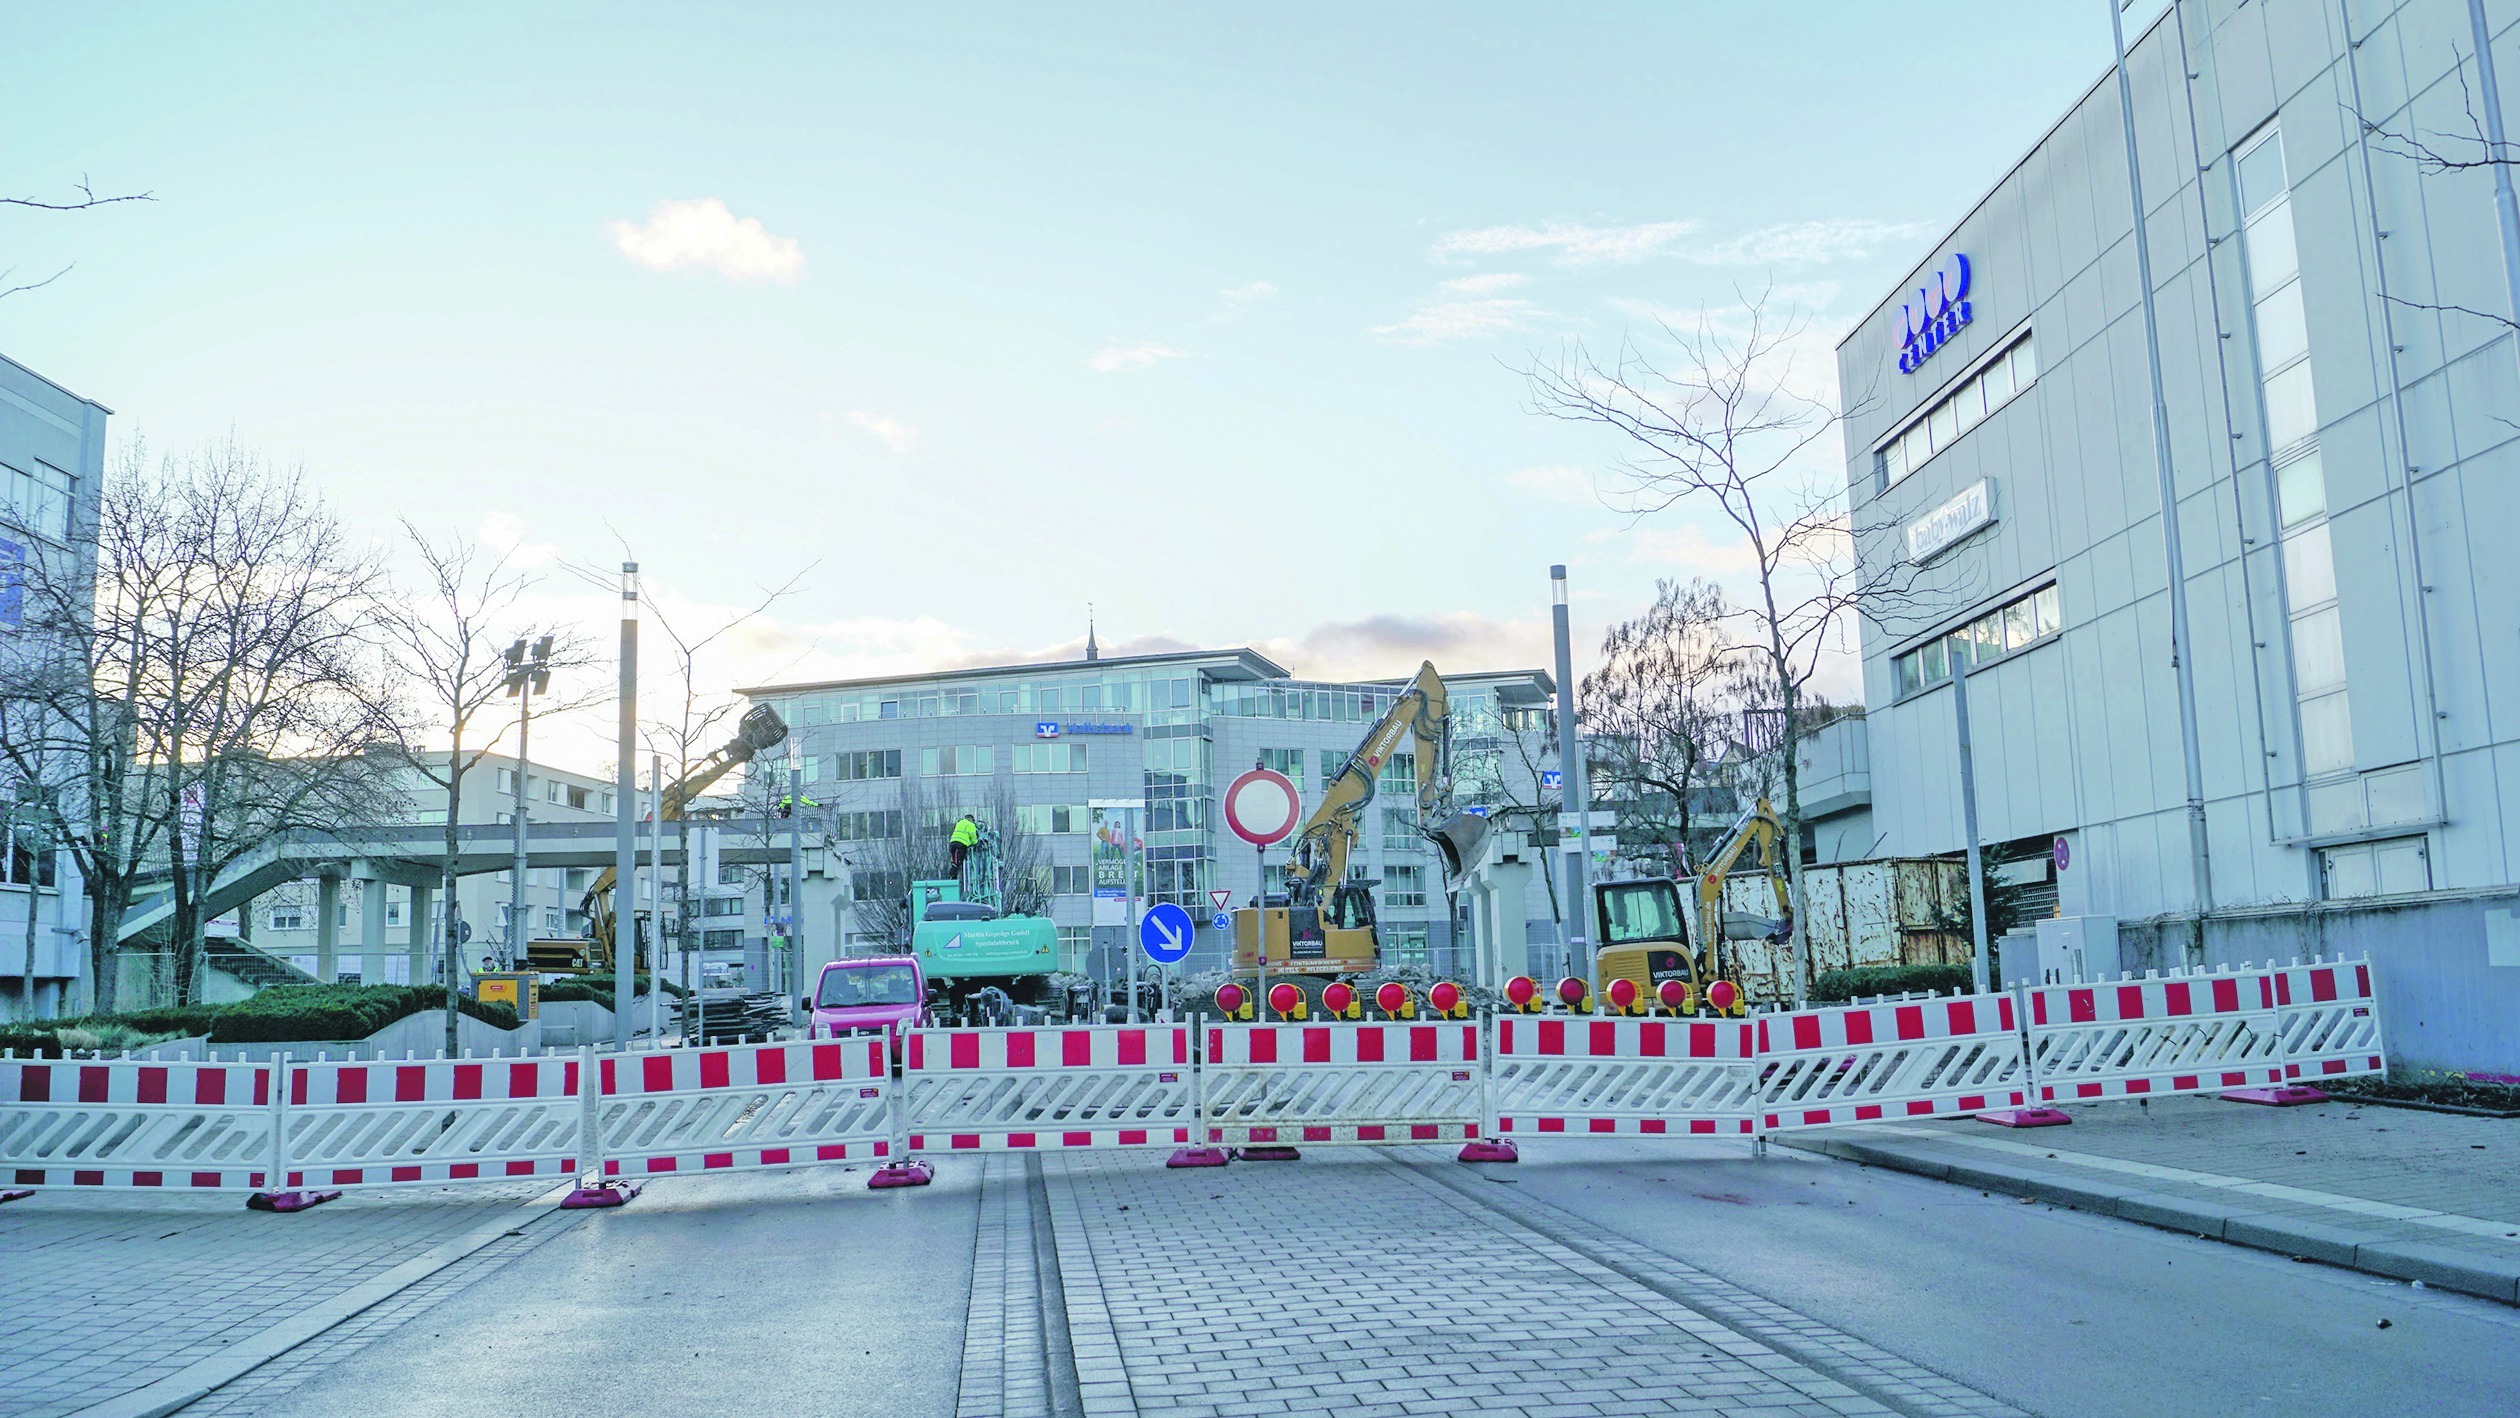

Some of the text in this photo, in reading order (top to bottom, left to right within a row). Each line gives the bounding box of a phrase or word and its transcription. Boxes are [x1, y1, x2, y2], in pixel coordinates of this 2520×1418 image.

[1898, 301, 1973, 375] CENTER
[1914, 495, 1980, 552] baby-walz
[1373, 720, 1402, 757] VIKTORBAU
[1713, 846, 1738, 877] VIKTORBAU
[1098, 871, 1139, 879] BRET
[1292, 940, 1323, 948] VIKTORBAU
[571, 958, 583, 968] CAT
[1653, 968, 1689, 979] VIKTORBAU
